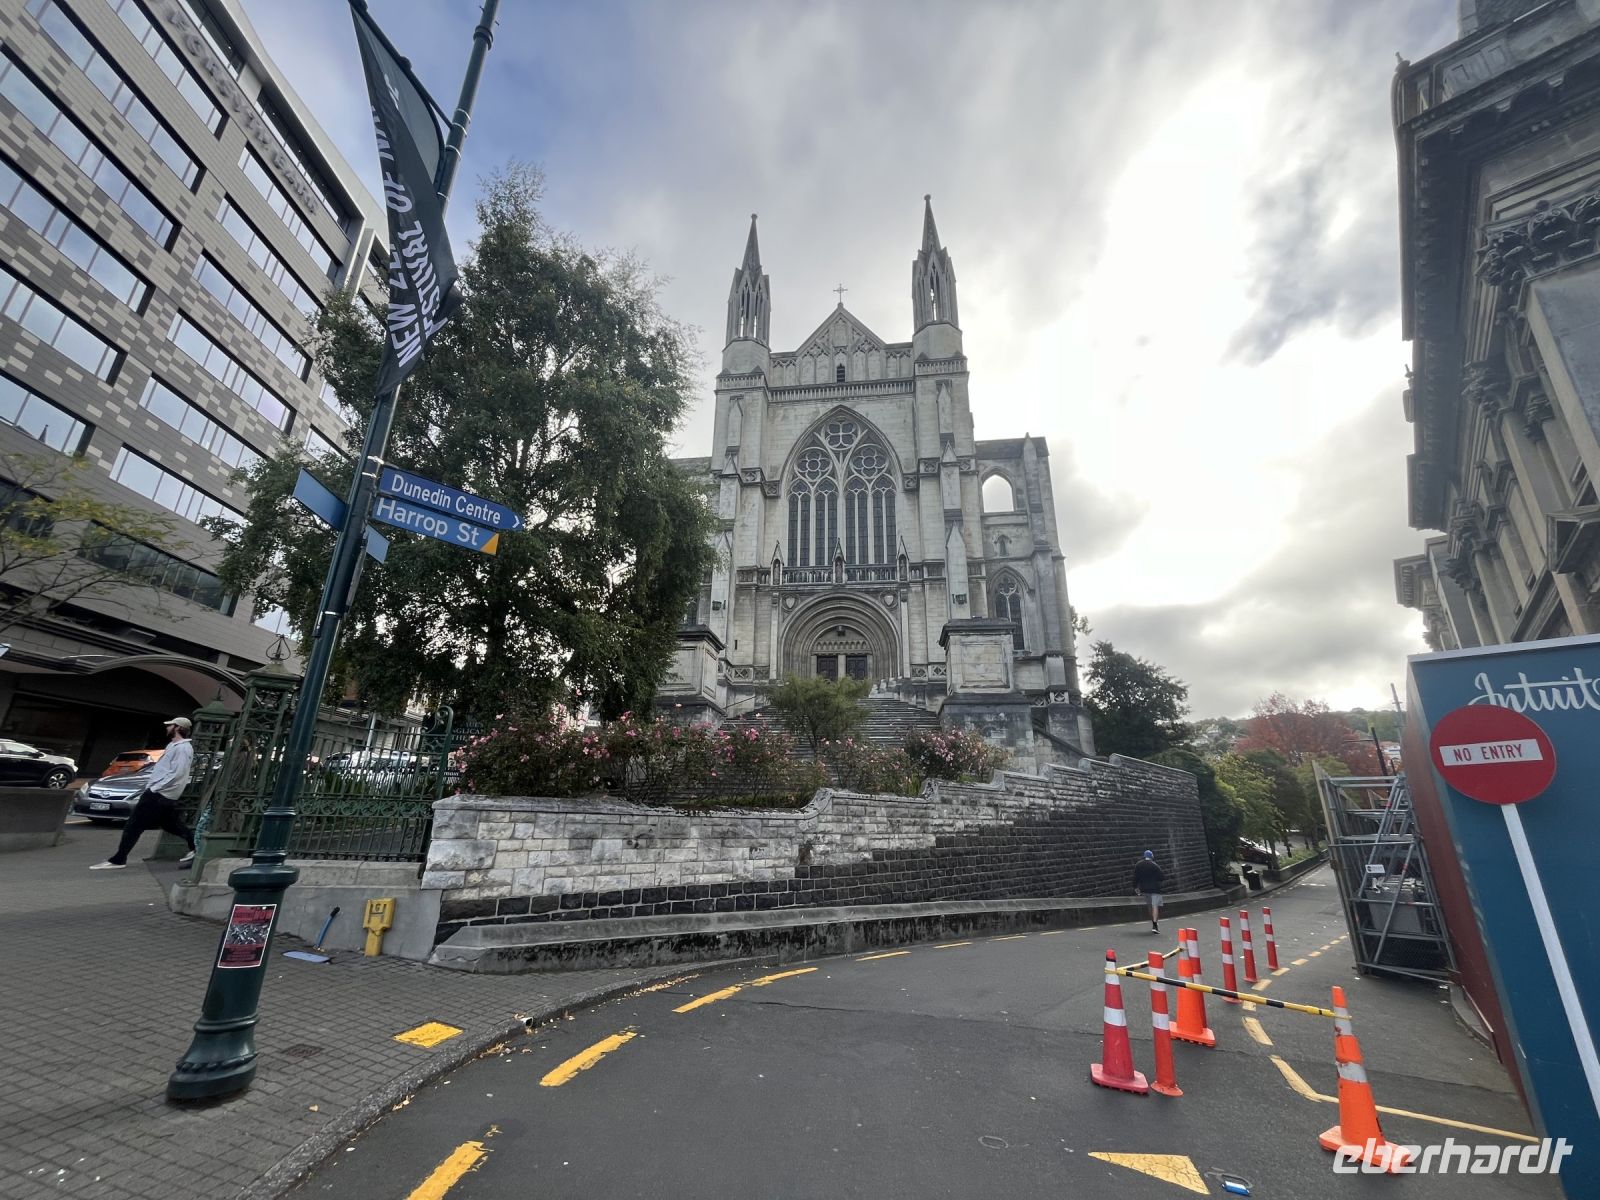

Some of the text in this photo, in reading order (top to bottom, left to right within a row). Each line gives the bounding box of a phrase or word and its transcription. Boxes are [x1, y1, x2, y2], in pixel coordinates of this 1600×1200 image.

[387, 303, 422, 368] NEW
[376, 497, 480, 546] Harrop St
[391, 474, 501, 525] Dunedin Centre
[1468, 667, 1600, 713] Intuit
[1453, 743, 1523, 762] NO ENTRY
